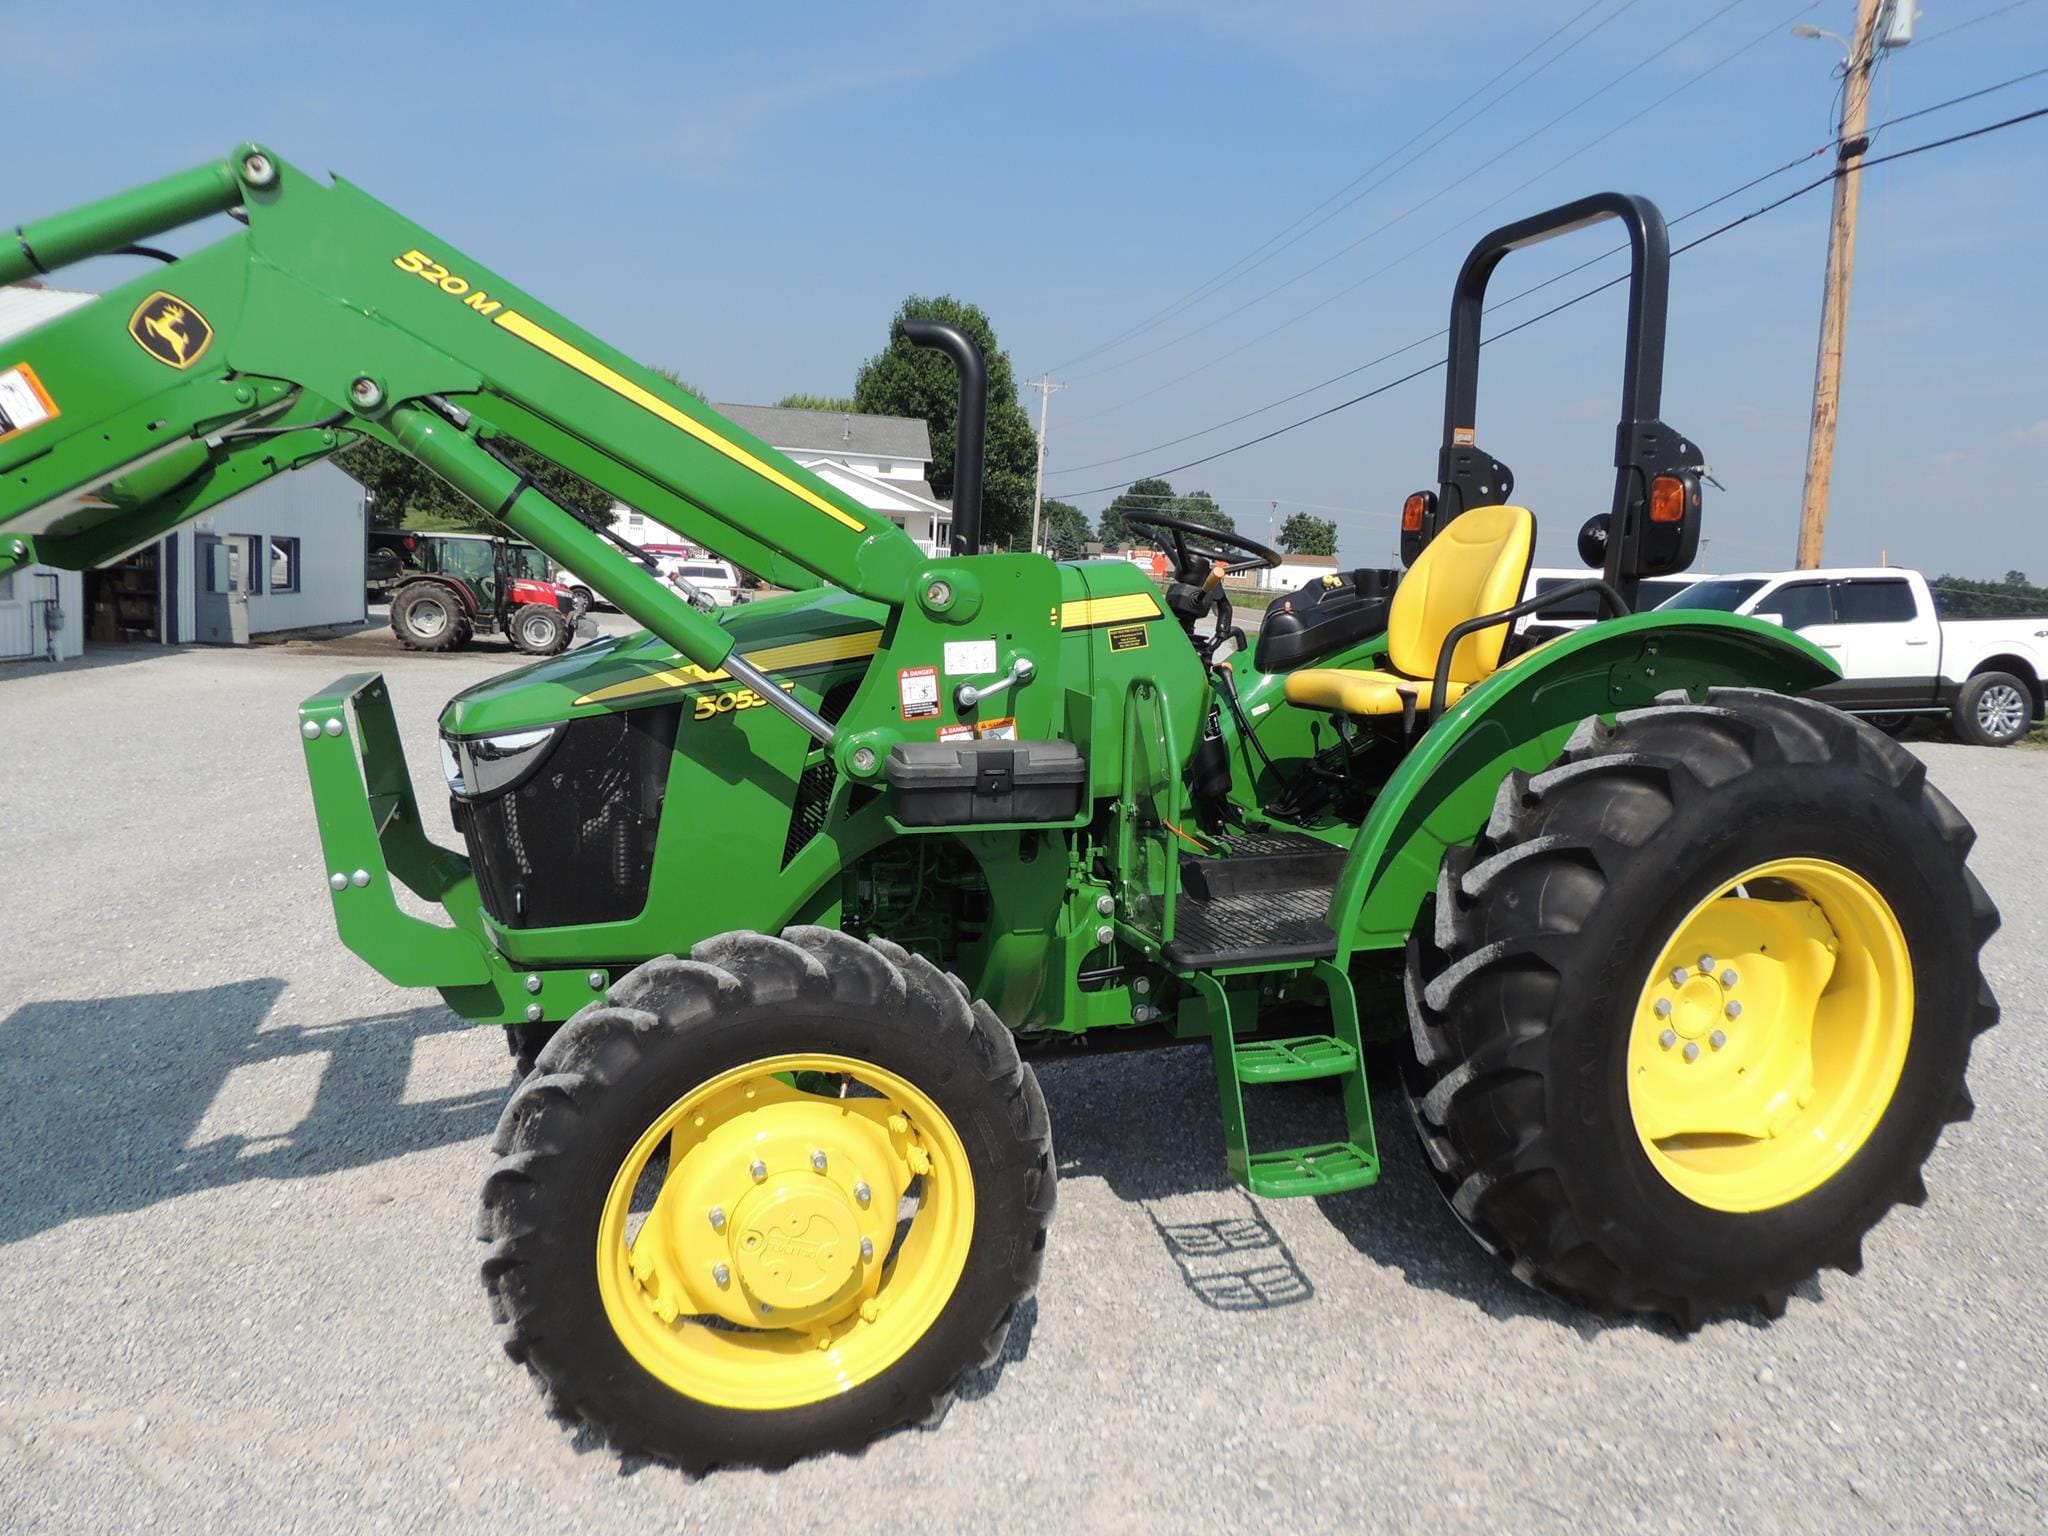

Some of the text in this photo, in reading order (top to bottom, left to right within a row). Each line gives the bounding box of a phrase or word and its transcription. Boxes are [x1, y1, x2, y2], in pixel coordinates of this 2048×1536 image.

[393, 249, 503, 316] 520 M
[909, 668, 934, 676] DANGER
